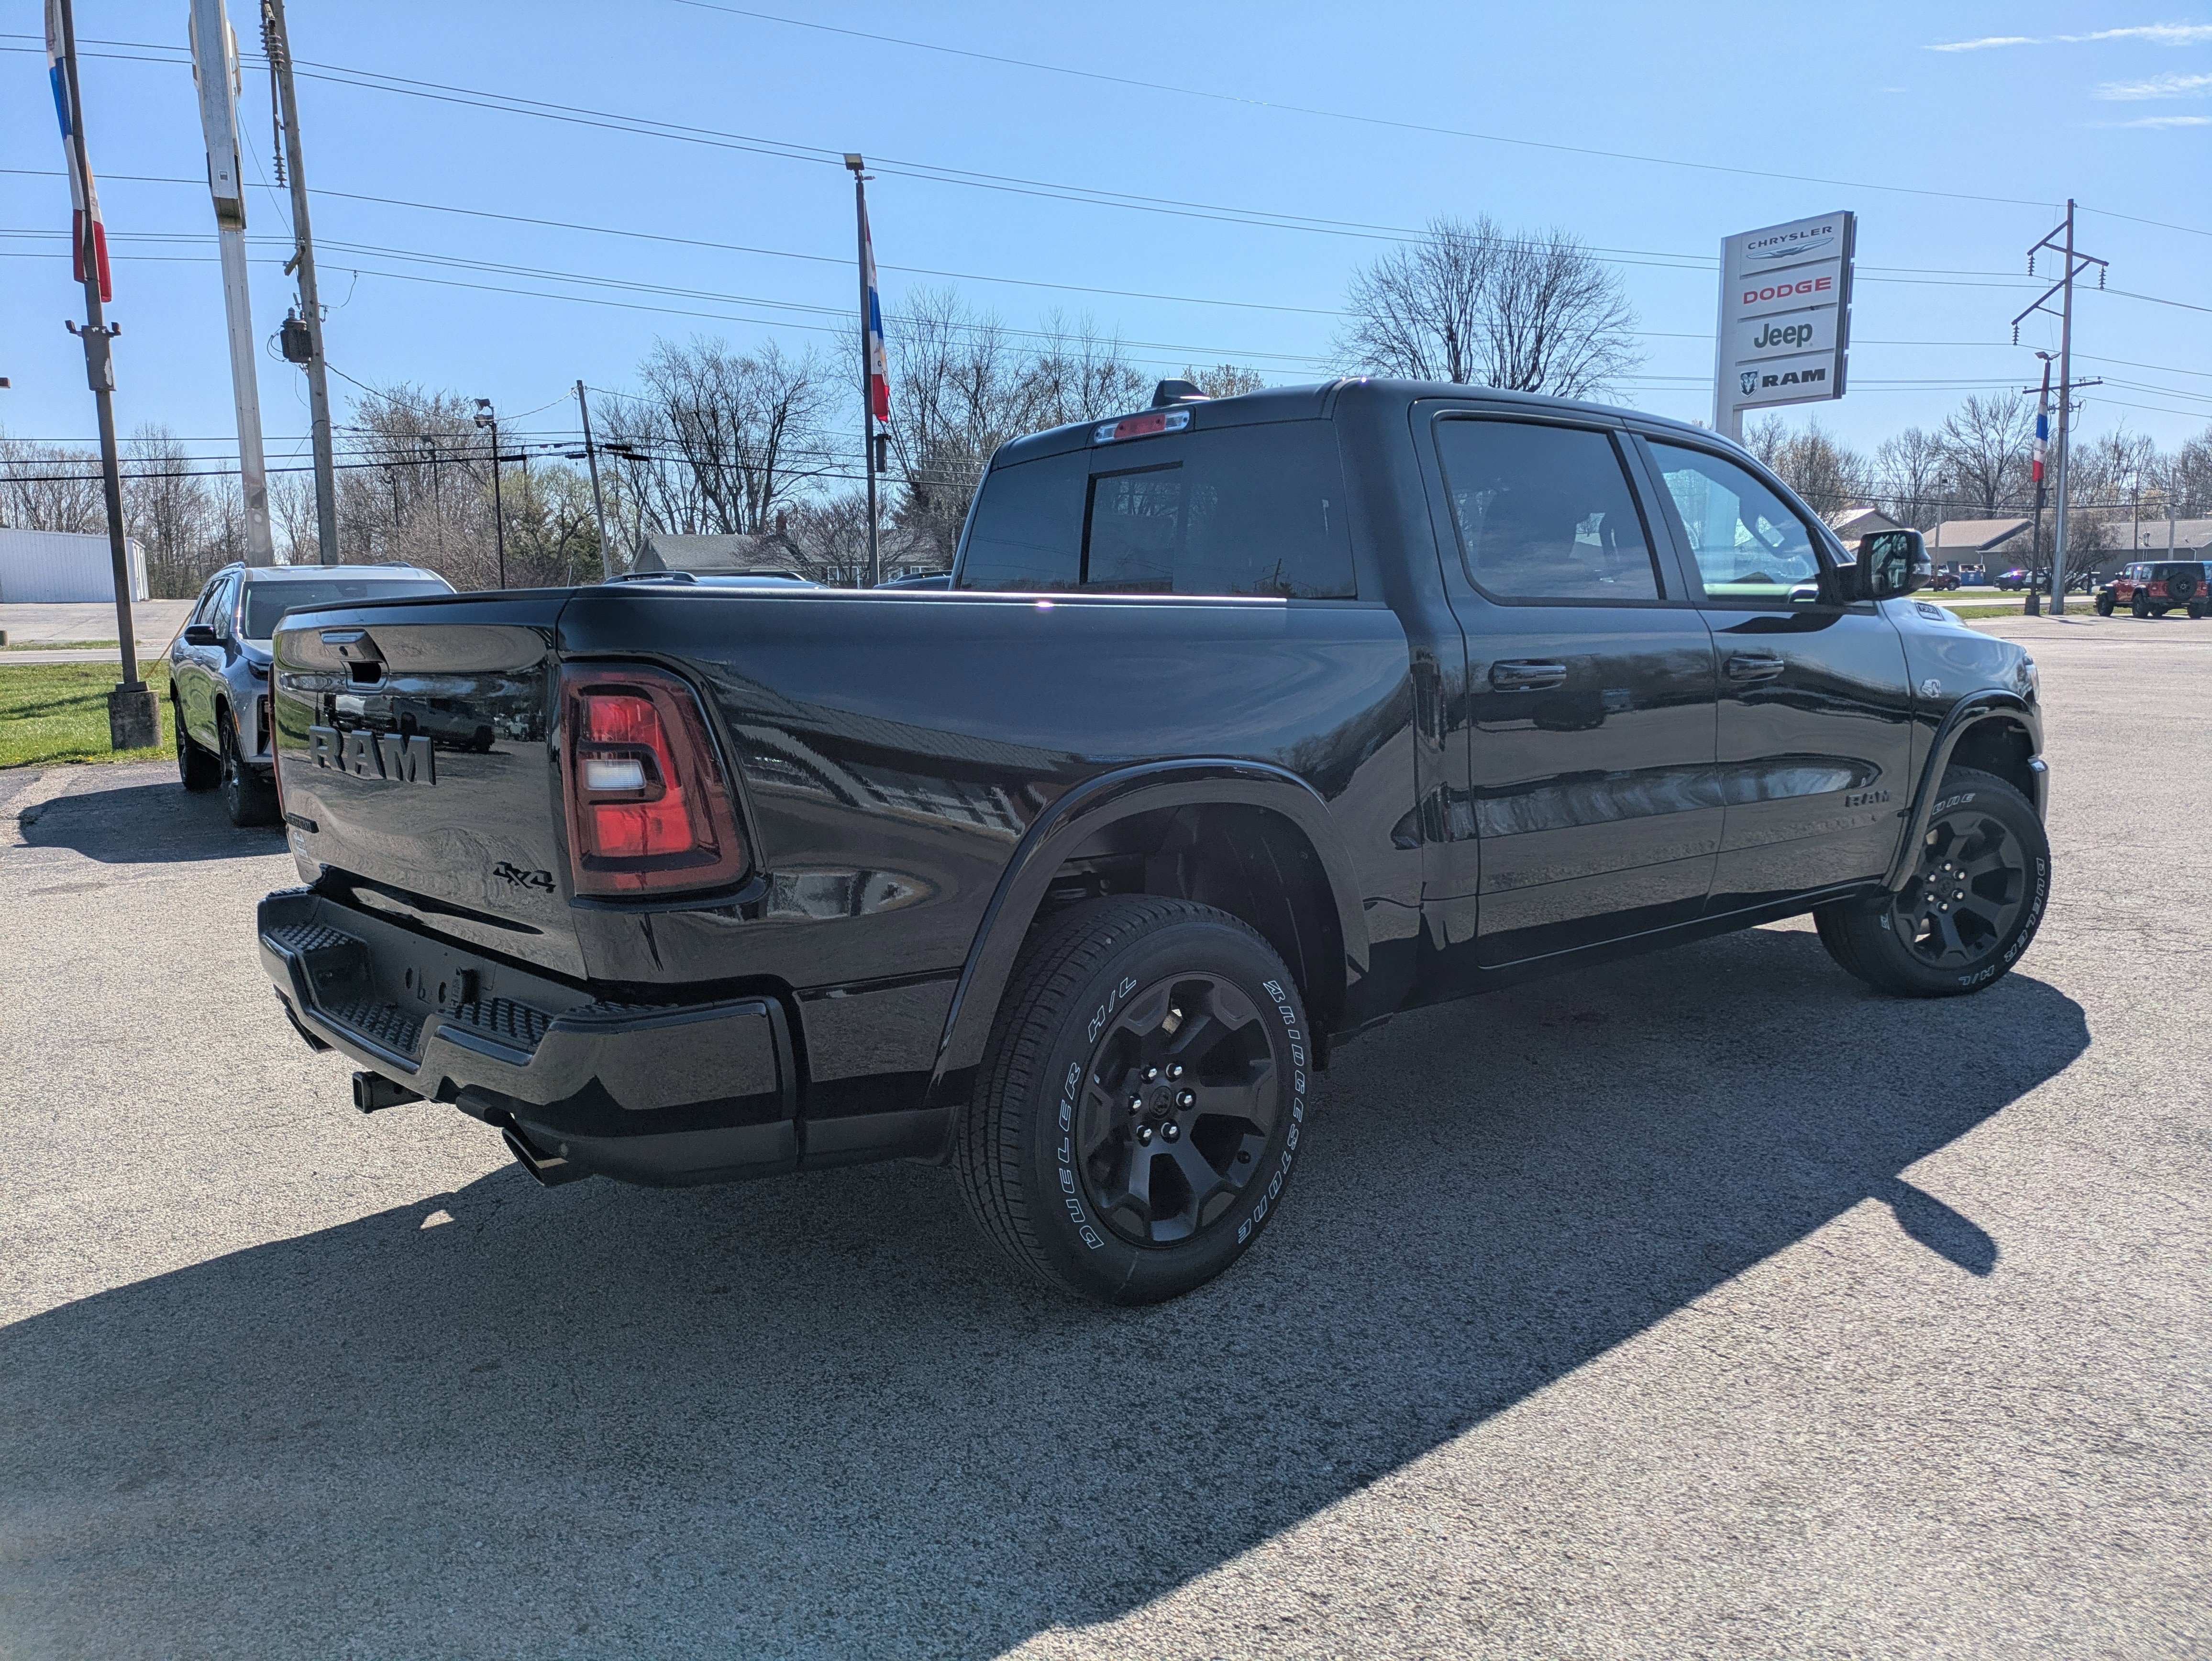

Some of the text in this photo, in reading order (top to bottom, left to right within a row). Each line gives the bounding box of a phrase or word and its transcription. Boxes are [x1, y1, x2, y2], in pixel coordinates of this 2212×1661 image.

[1747, 226, 1833, 250] CHRYSLER
[1743, 276, 1832, 305] DODGE
[1754, 322, 1813, 348] Jeep
[1762, 368, 1826, 388] RAM
[309, 725, 436, 786] RAM
[1845, 789, 1890, 808] RAM
[2004, 857, 2046, 963] DUELER
[1058, 976, 1137, 1250] DUELER H/L
[1238, 979, 1305, 1244] BRIDGESTONE
